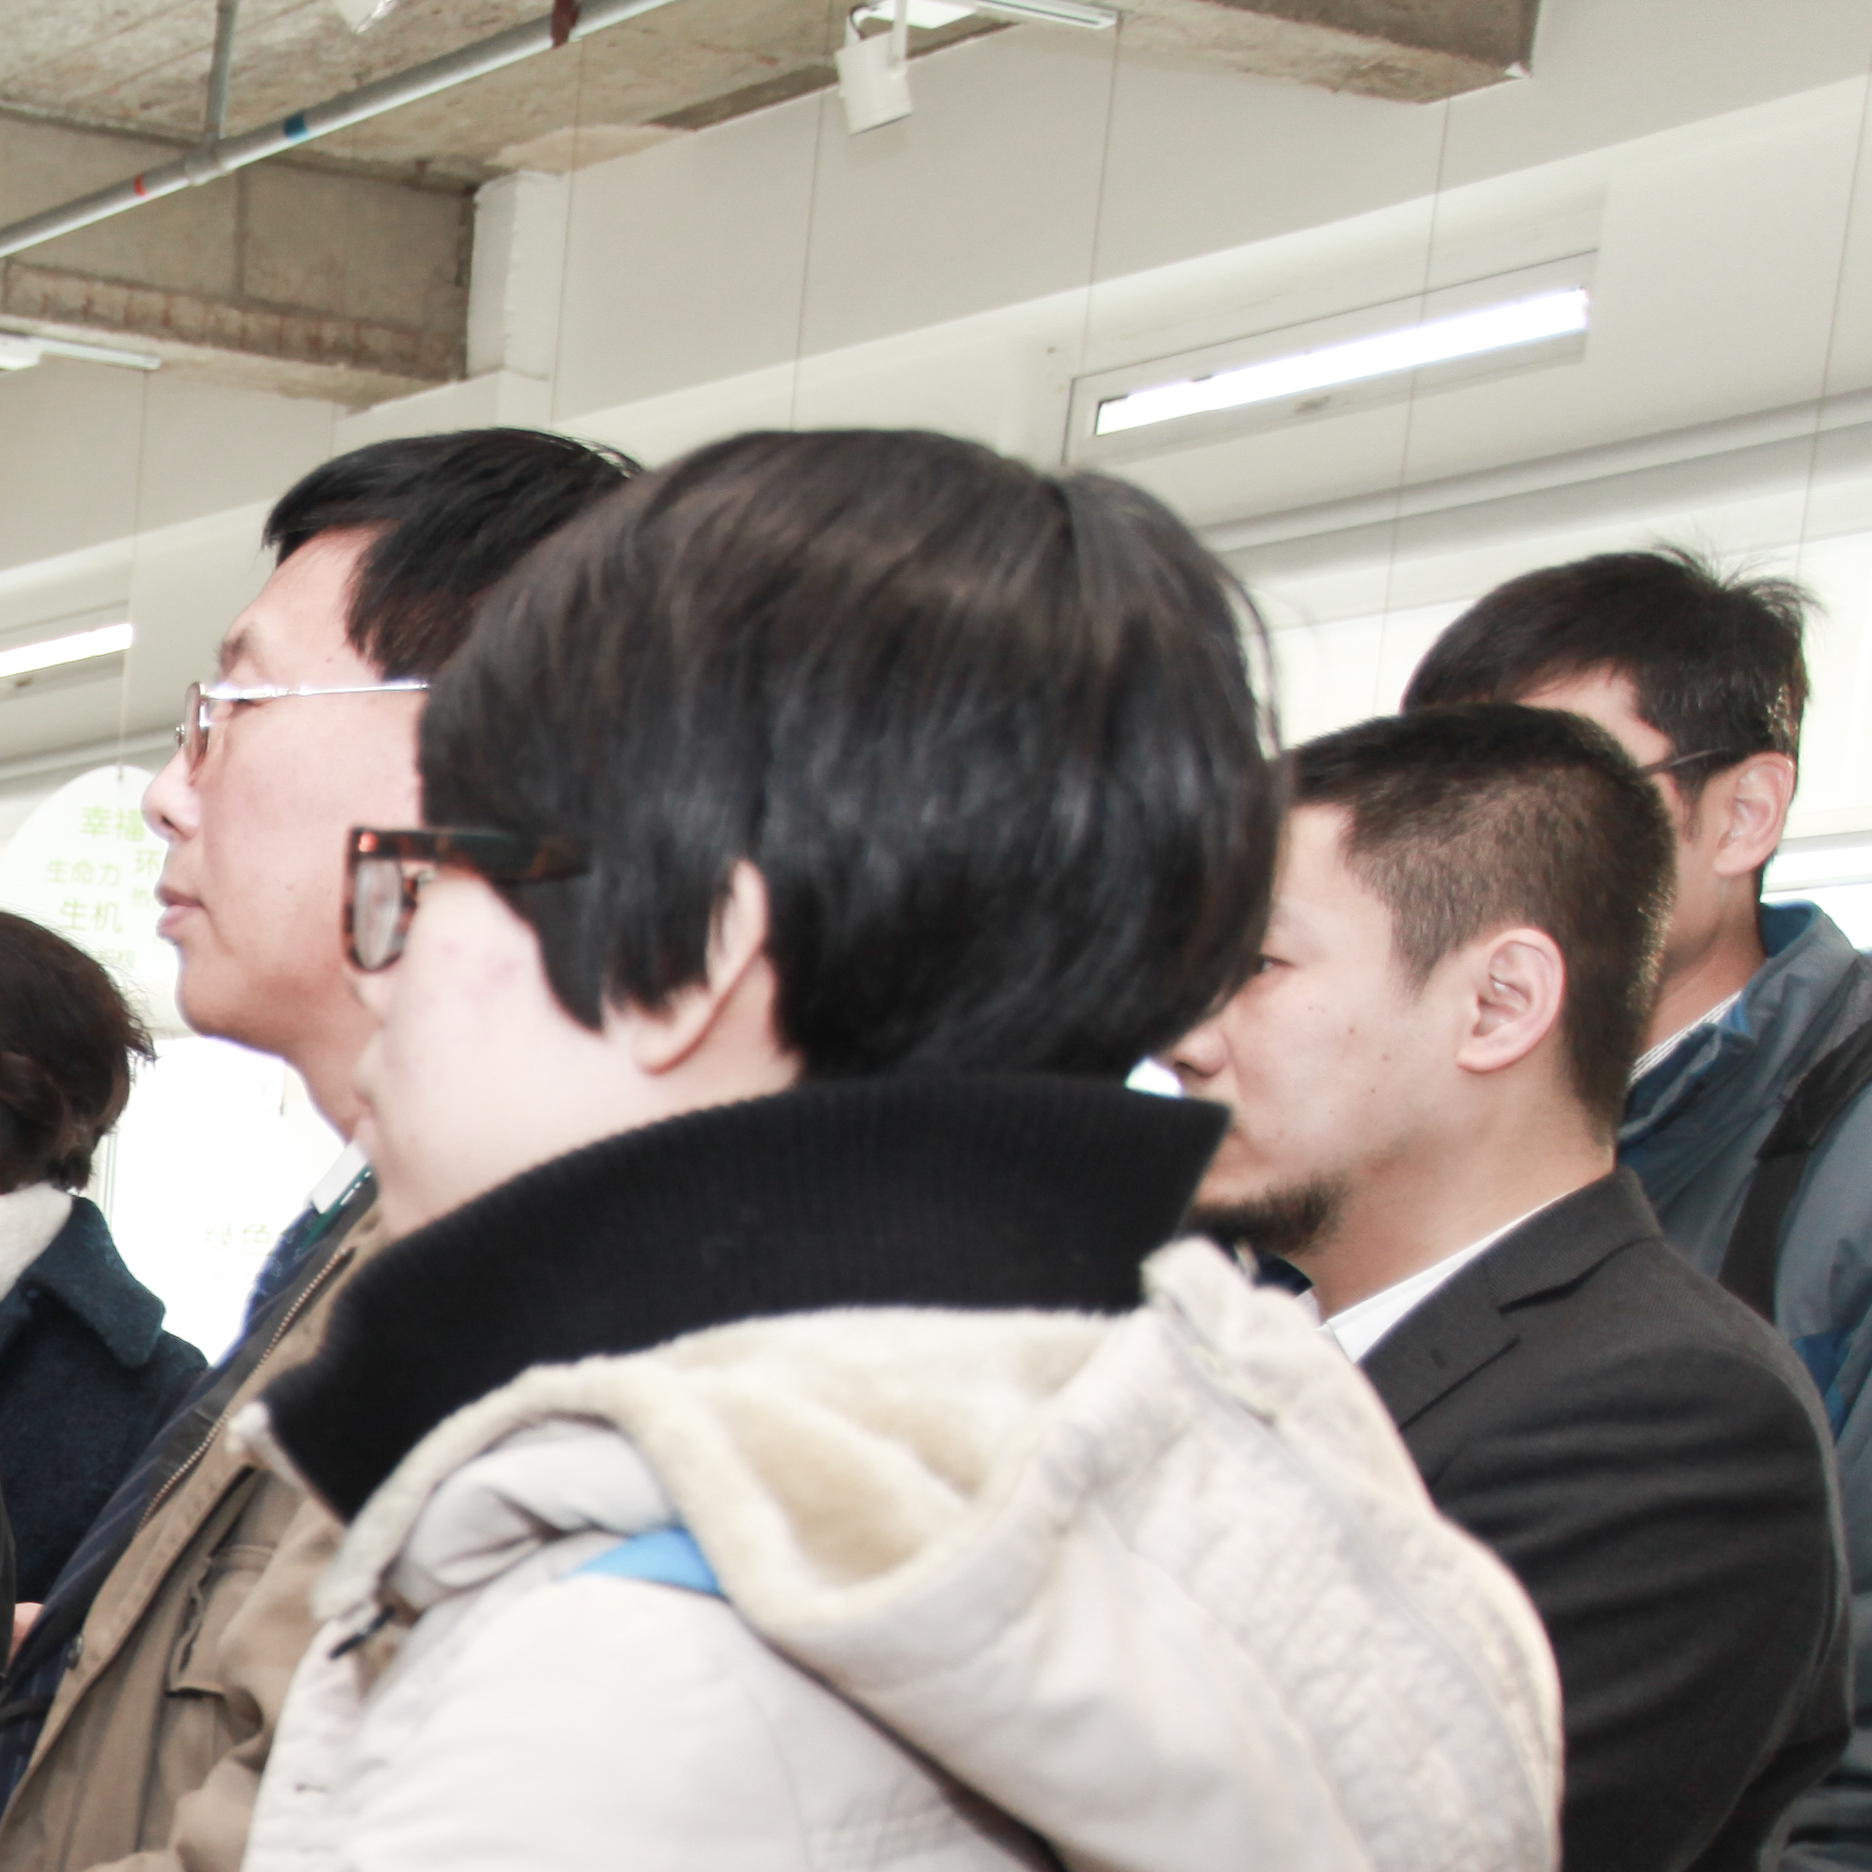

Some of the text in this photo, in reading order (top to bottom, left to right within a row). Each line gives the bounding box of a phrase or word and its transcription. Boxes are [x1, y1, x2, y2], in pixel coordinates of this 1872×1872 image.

[46, 857, 122, 887] 生命力
[59, 896, 124, 933] 生机
